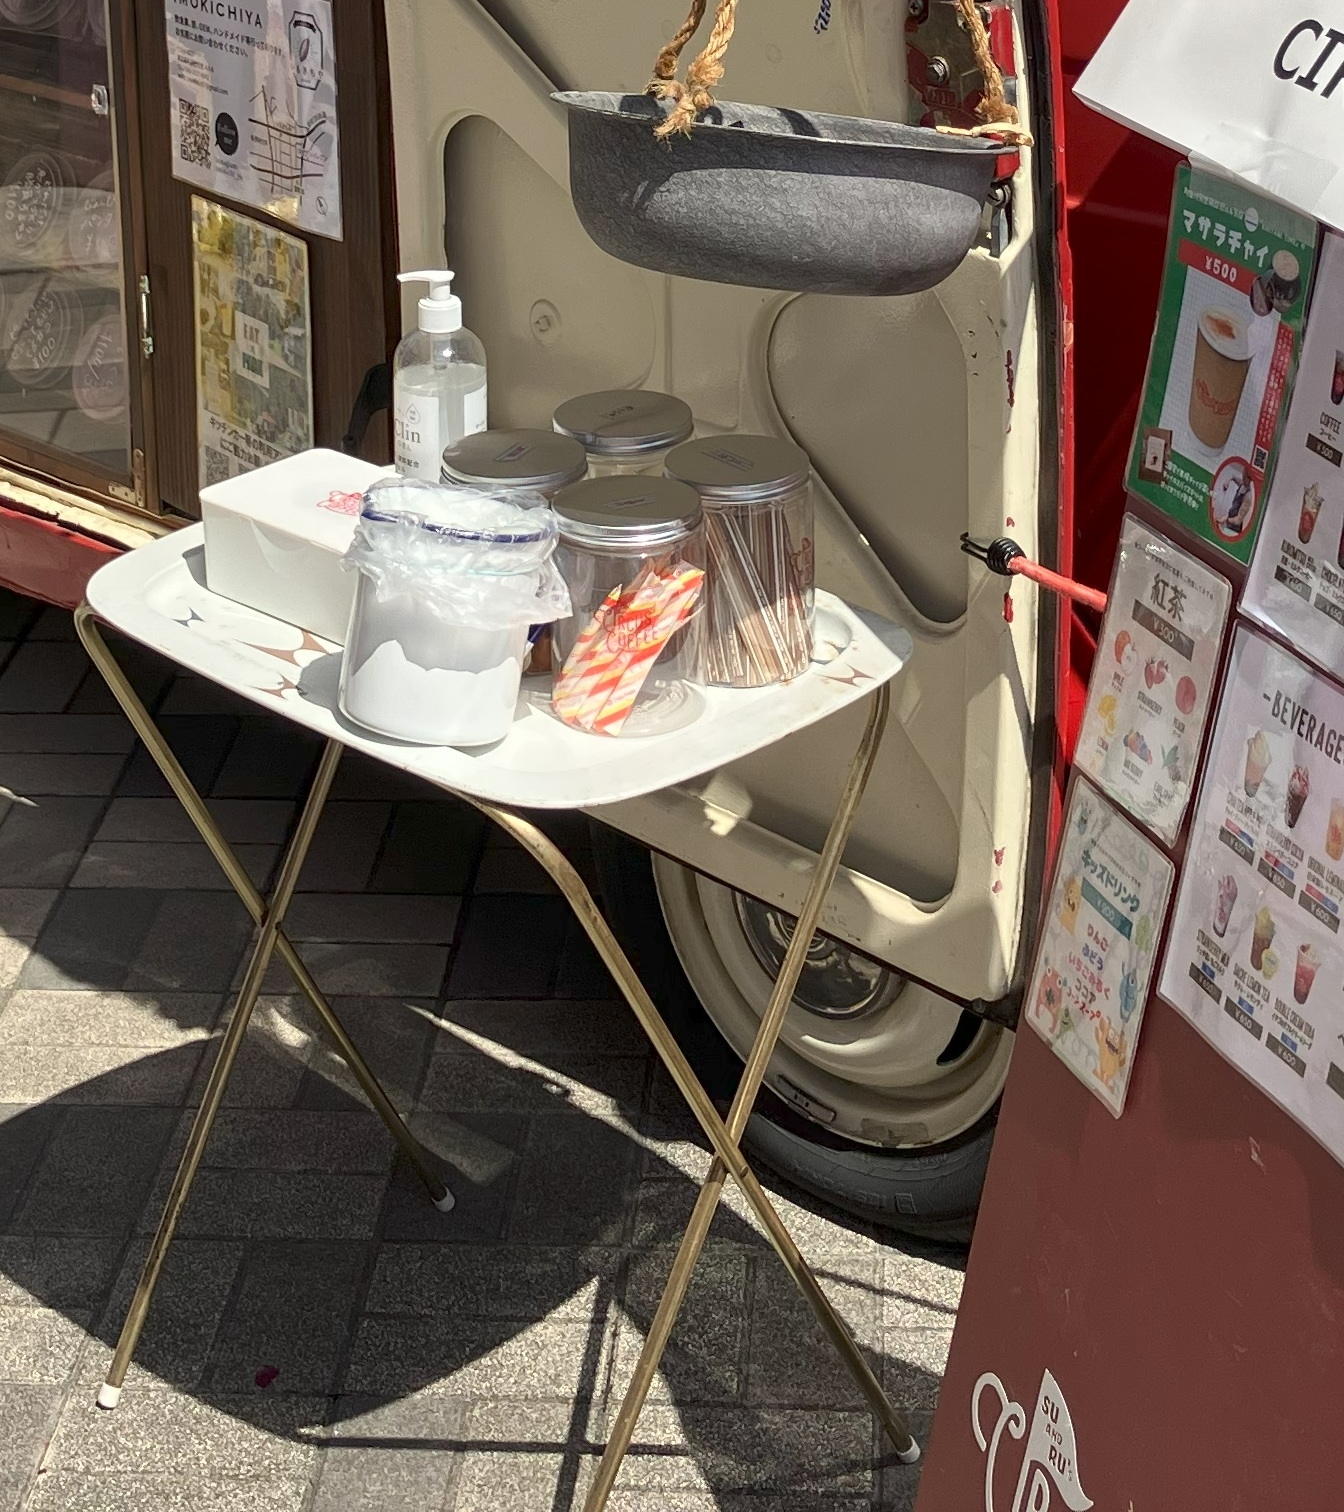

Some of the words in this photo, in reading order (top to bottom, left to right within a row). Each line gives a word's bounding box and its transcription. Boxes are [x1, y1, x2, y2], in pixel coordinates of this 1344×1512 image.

[1183, 209, 1269, 268] マサラチャイ
[1205, 255, 1238, 283] ¥500
[1320, 412, 1341, 434] COFFEE
[1150, 573, 1187, 622] 紅茶
[1082, 849, 1141, 913] キッズドリンク
[1041, 1395, 1060, 1425] SU
[1045, 1422, 1063, 1446] AND
